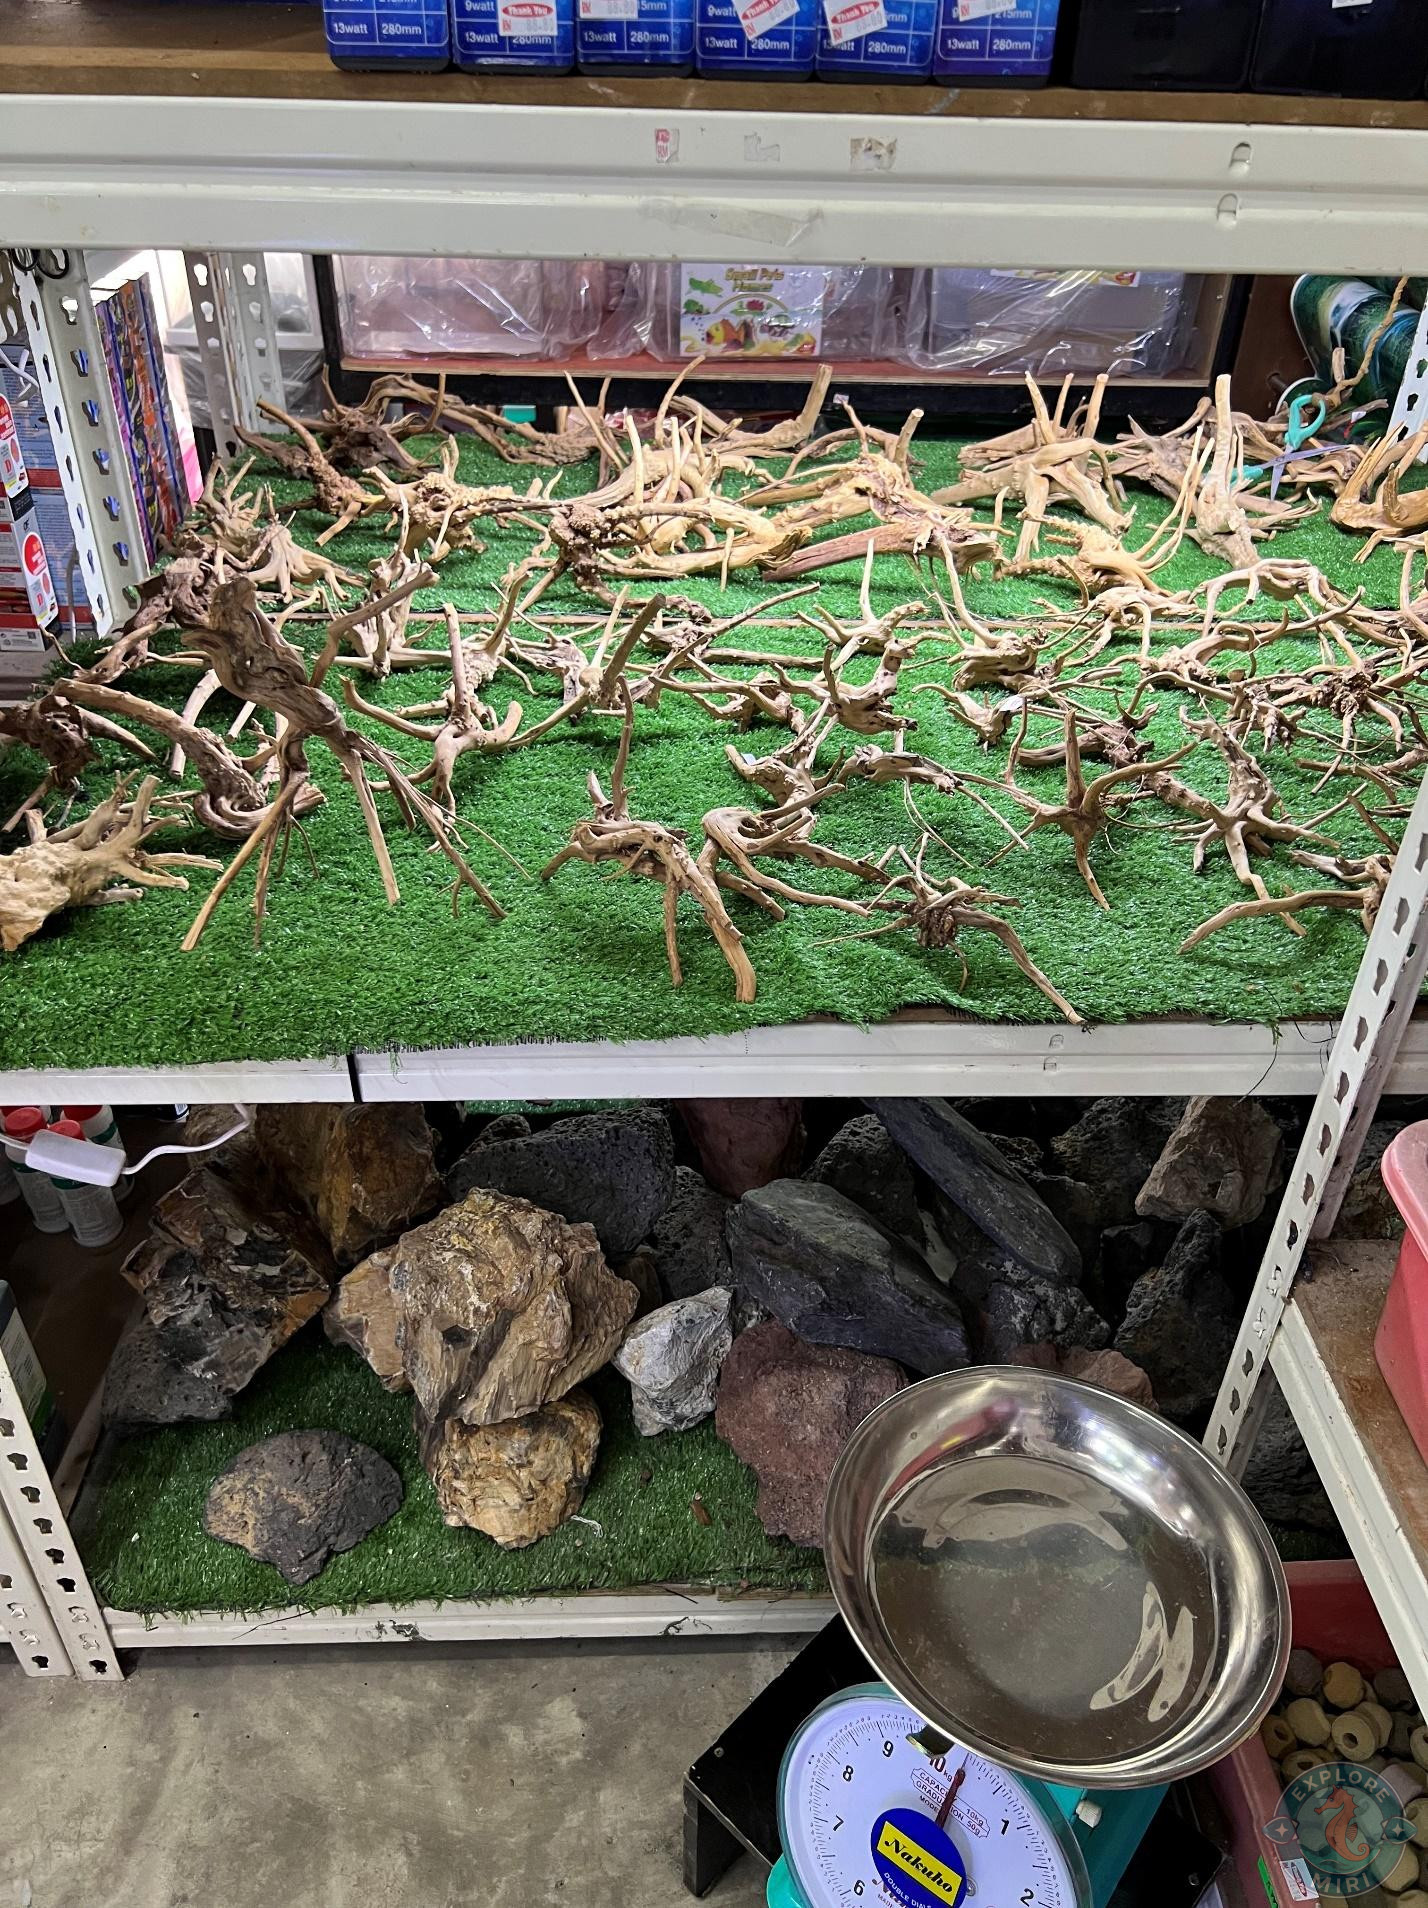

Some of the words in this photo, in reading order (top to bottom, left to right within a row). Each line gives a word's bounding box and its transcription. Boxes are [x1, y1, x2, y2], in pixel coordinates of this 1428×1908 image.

[465, 0, 495, 11] 9watt
[334, 23, 368, 34] 13watt
[381, 23, 421, 35] 280mm
[584, 31, 617, 42] 13watt
[630, 31, 670, 43] 280mm
[465, 32, 499, 43] 13watt
[512, 35, 552, 45] 280mm
[705, 37, 738, 48] 13watt
[752, 39, 790, 50] 280mm
[867, 41, 906, 54] 280mm
[947, 39, 979, 50] 13watt
[993, 39, 1032, 51] 280mm
[882, 1740, 894, 1758] 9
[842, 1764, 854, 1782] 8
[832, 1814, 845, 1832] 7
[966, 1808, 984, 1828] 10kg
[1001, 1818, 1010, 1836] 1
[966, 1820, 981, 1837] 50g
[884, 1839, 953, 1893] Nakuho
[853, 1879, 866, 1897] 6
[883, 1872, 910, 1902] DOUBLE
[1020, 1887, 1035, 1907] 2
